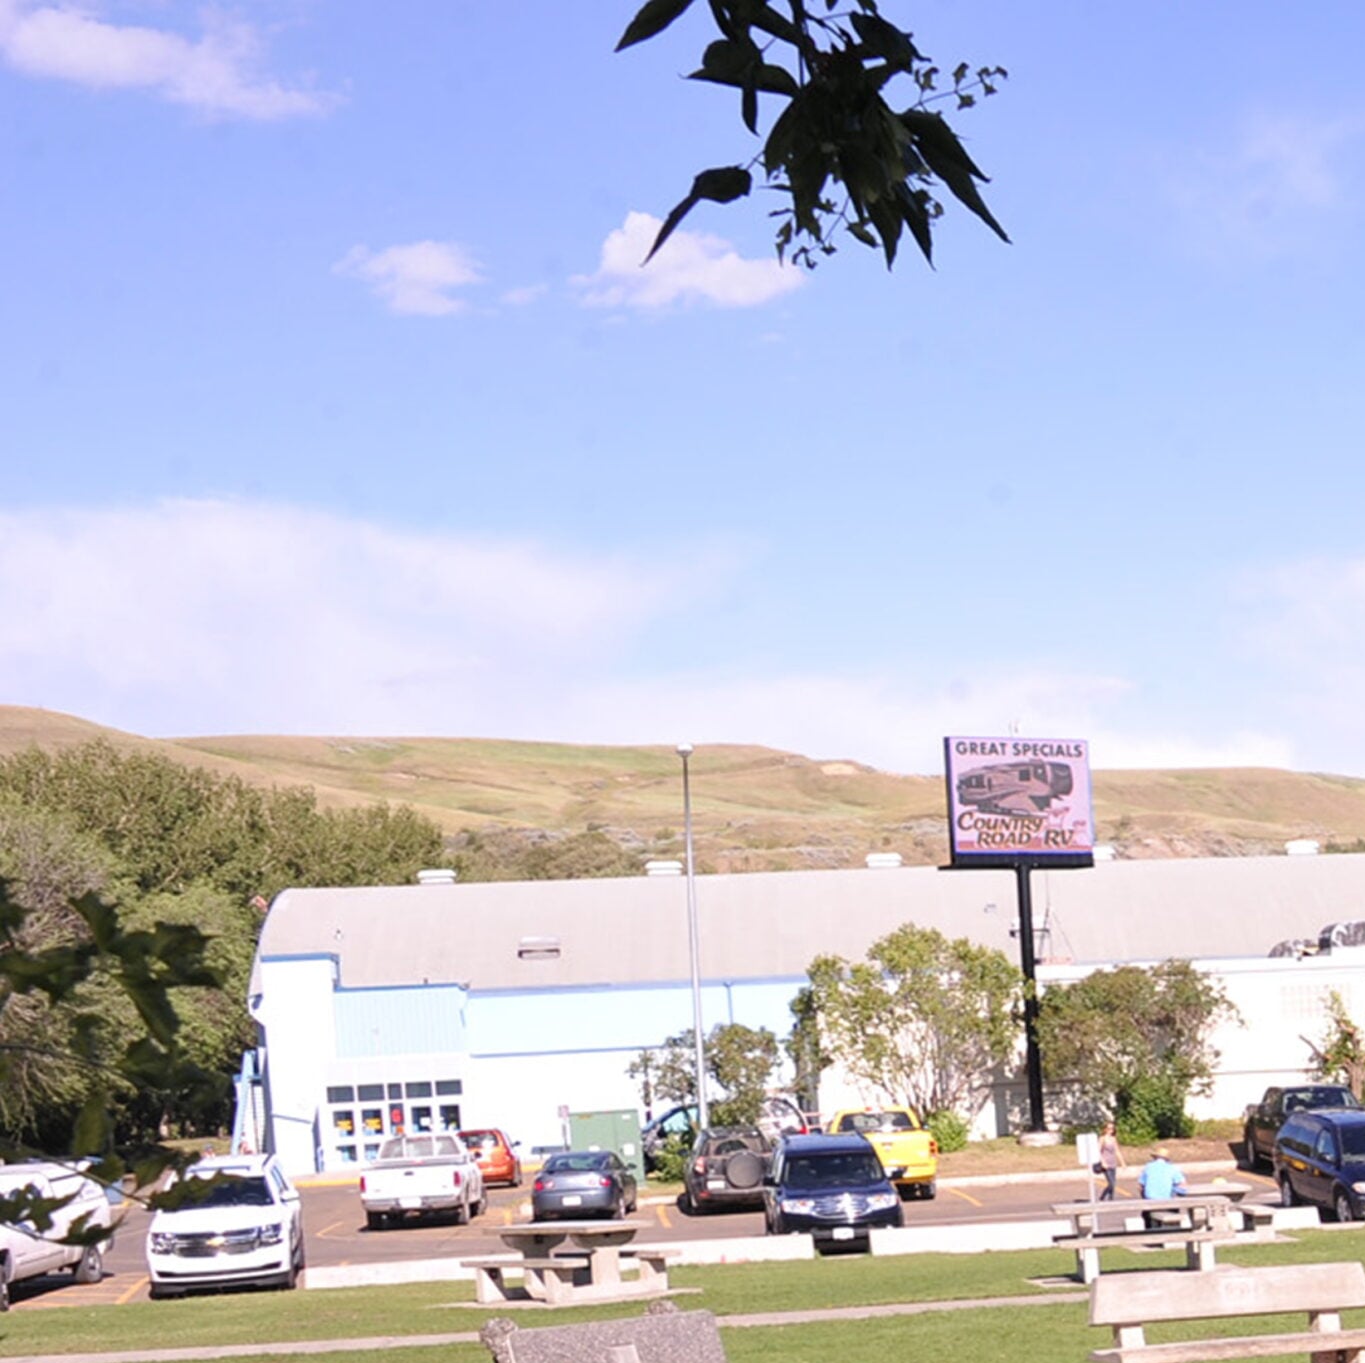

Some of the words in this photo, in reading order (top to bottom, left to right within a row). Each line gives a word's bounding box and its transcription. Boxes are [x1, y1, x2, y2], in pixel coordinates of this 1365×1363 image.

[955, 741, 1007, 756] GREAT
[1012, 742, 1083, 758] SPECIALS
[957, 810, 1044, 833] COUNTRY
[976, 830, 1032, 847] ROAD
[1043, 829, 1075, 847] RV
